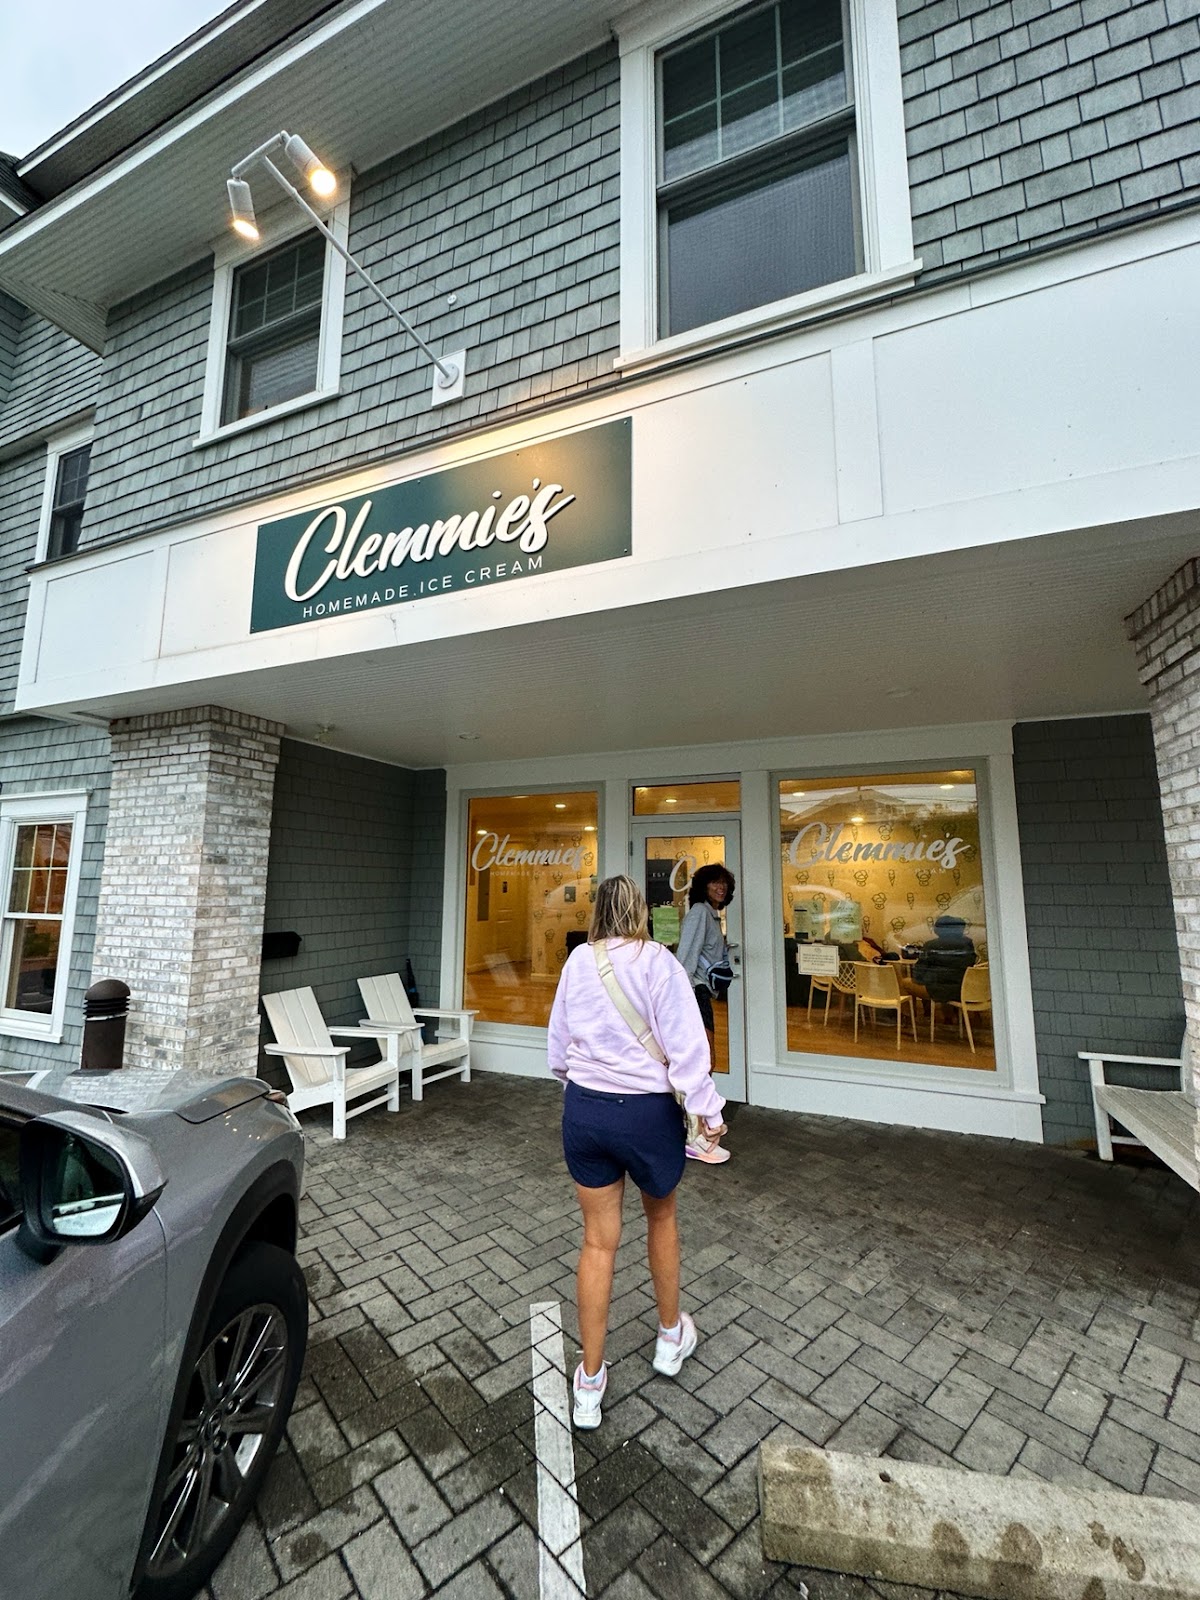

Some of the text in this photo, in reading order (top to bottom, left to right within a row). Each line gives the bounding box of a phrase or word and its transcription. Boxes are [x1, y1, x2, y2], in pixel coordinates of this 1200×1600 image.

[285, 478, 575, 601] Clemmie's
[303, 556, 543, 618] HOMEMADE ICE CREAM
[788, 821, 971, 869] Clemmie's
